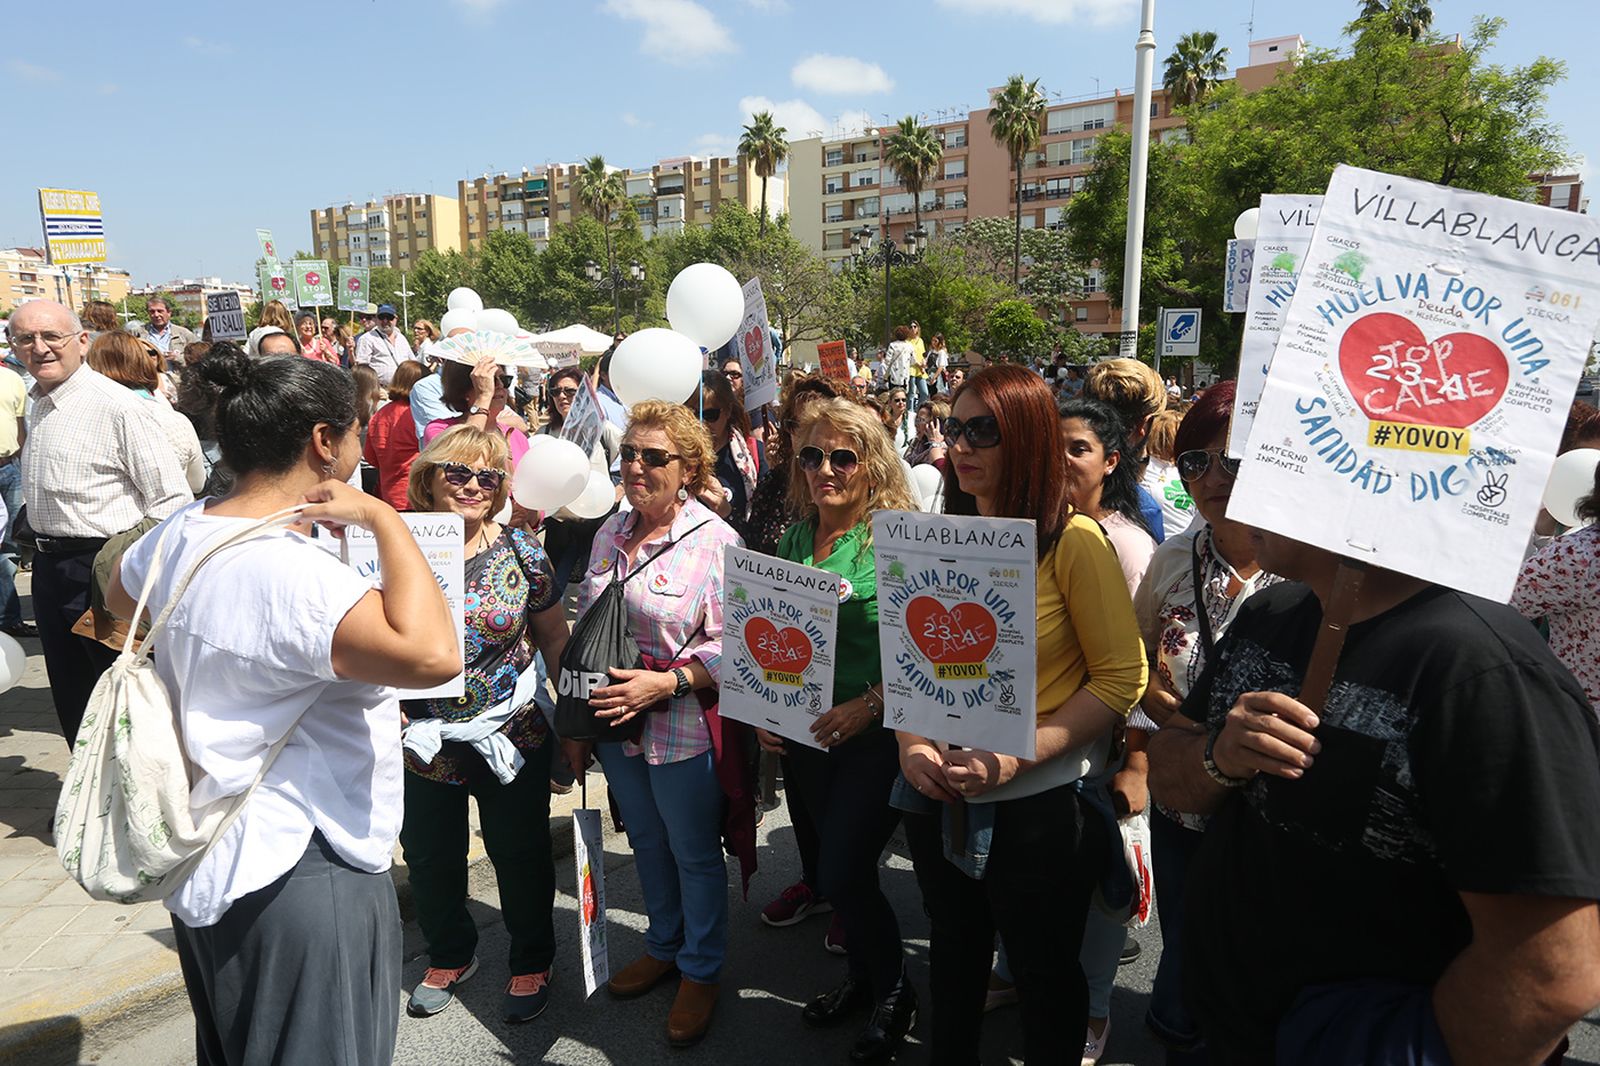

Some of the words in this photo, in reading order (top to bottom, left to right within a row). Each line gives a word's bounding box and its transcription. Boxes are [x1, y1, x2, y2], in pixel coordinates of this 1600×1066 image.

[1354, 184, 1600, 266] VILLABLANCA
[208, 298, 219, 311] SE
[1417, 298, 1464, 319] Deuda
[1550, 291, 1582, 309] 061
[210, 315, 221, 333] TU
[1316, 273, 1430, 327] HUELVA
[1442, 277, 1502, 326] POR
[1501, 317, 1551, 376] UNA
[1526, 306, 1571, 324] SIERRA
[1365, 353, 1468, 400] 23-A
[1508, 389, 1553, 405] RIOTINTO
[1514, 382, 1550, 396] Hospital
[1504, 397, 1552, 414] COMPLETO
[1295, 396, 1393, 495] SANIDAD
[1373, 425, 1465, 450] #YOVOY
[1255, 453, 1306, 475] INFANTIL
[1259, 443, 1309, 464] MATERNO
[1461, 508, 1509, 526] COMPLETOS
[1469, 503, 1510, 520] HOSPITALES
[886, 517, 1026, 549] VILLABLANCA
[734, 555, 840, 597] VILLABLANCA
[888, 568, 941, 609] HUELVA
[946, 569, 980, 597] POR
[983, 588, 1017, 624] UNA
[731, 597, 775, 624] HUELVA
[778, 600, 803, 625] POR
[804, 620, 828, 649] UNA
[923, 622, 978, 645] 23-A
[757, 637, 798, 661] 23-A
[733, 658, 778, 704] SANIDAD
[766, 671, 801, 684] #YOVOY
[896, 652, 956, 706] SANIDAD
[938, 664, 983, 678] #YOVOY
